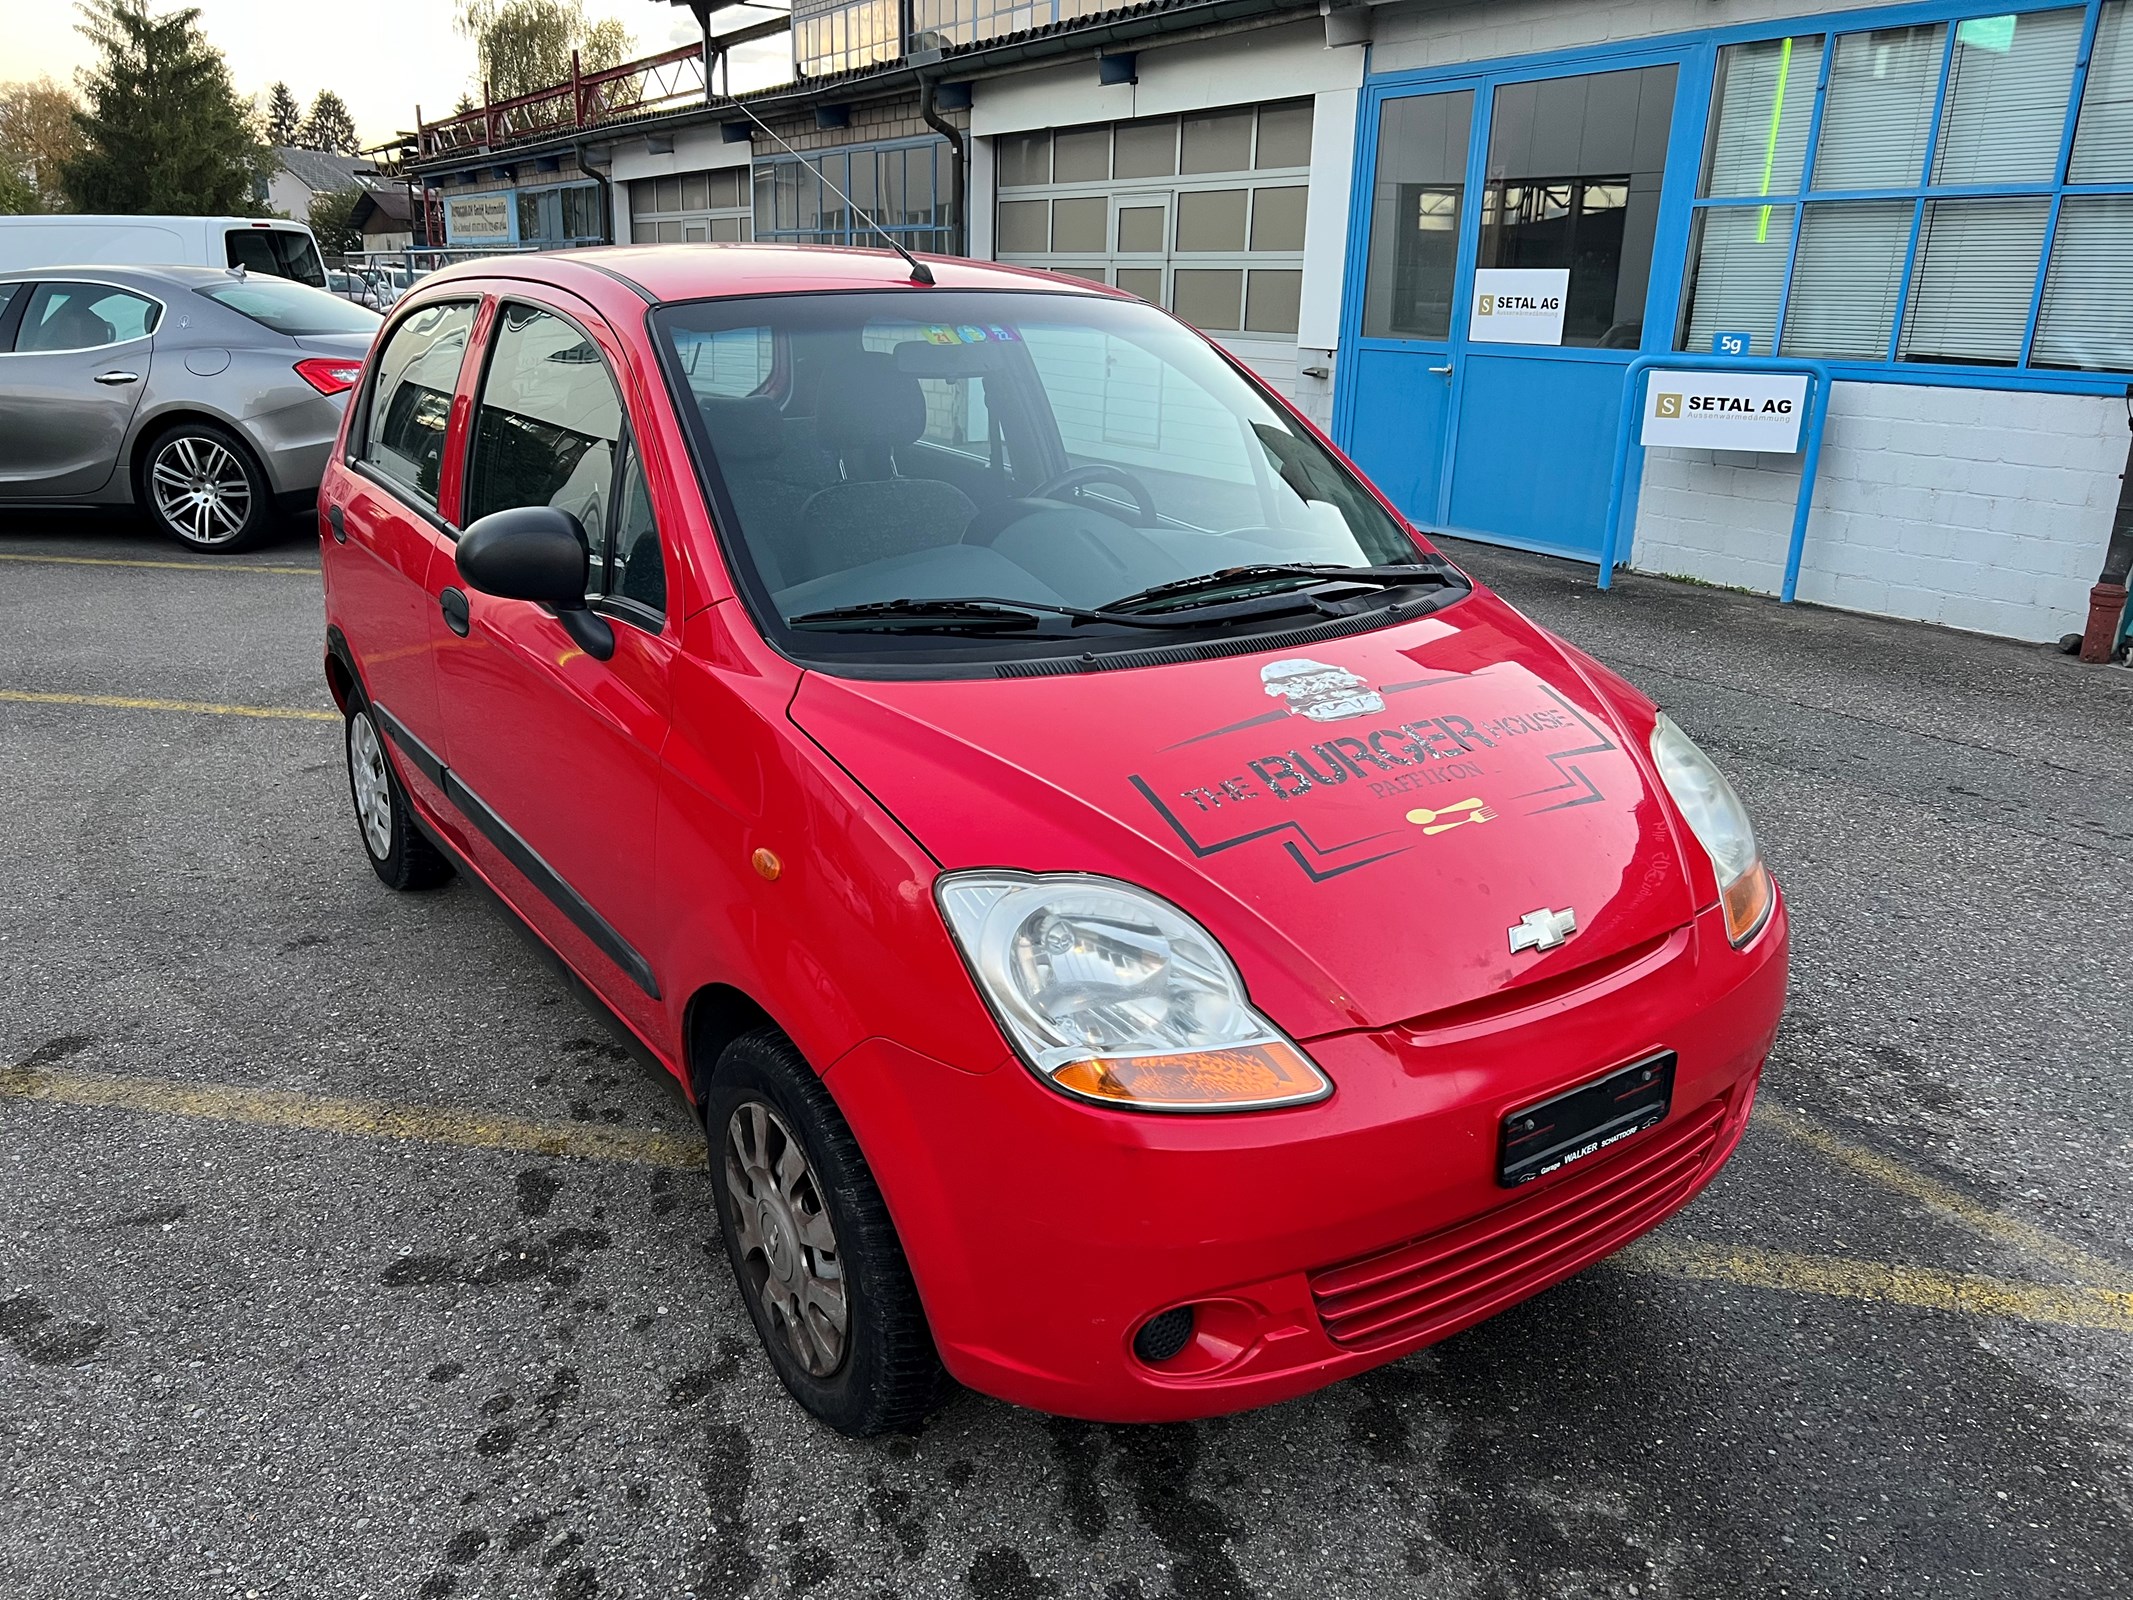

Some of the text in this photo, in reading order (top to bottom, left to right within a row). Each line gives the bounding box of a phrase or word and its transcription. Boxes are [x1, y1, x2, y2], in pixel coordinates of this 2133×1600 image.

[1497, 296, 1559, 310] SETAL AG
[1720, 335, 1742, 354] 5g
[1688, 396, 1792, 414] SETAL AG
[1687, 411, 1791, 423] Aussenwärmedämmung
[1180, 708, 1574, 812] THE BURGER HOUSE
[1541, 1125, 1638, 1175] Garage WALKER SCHATTDORF
